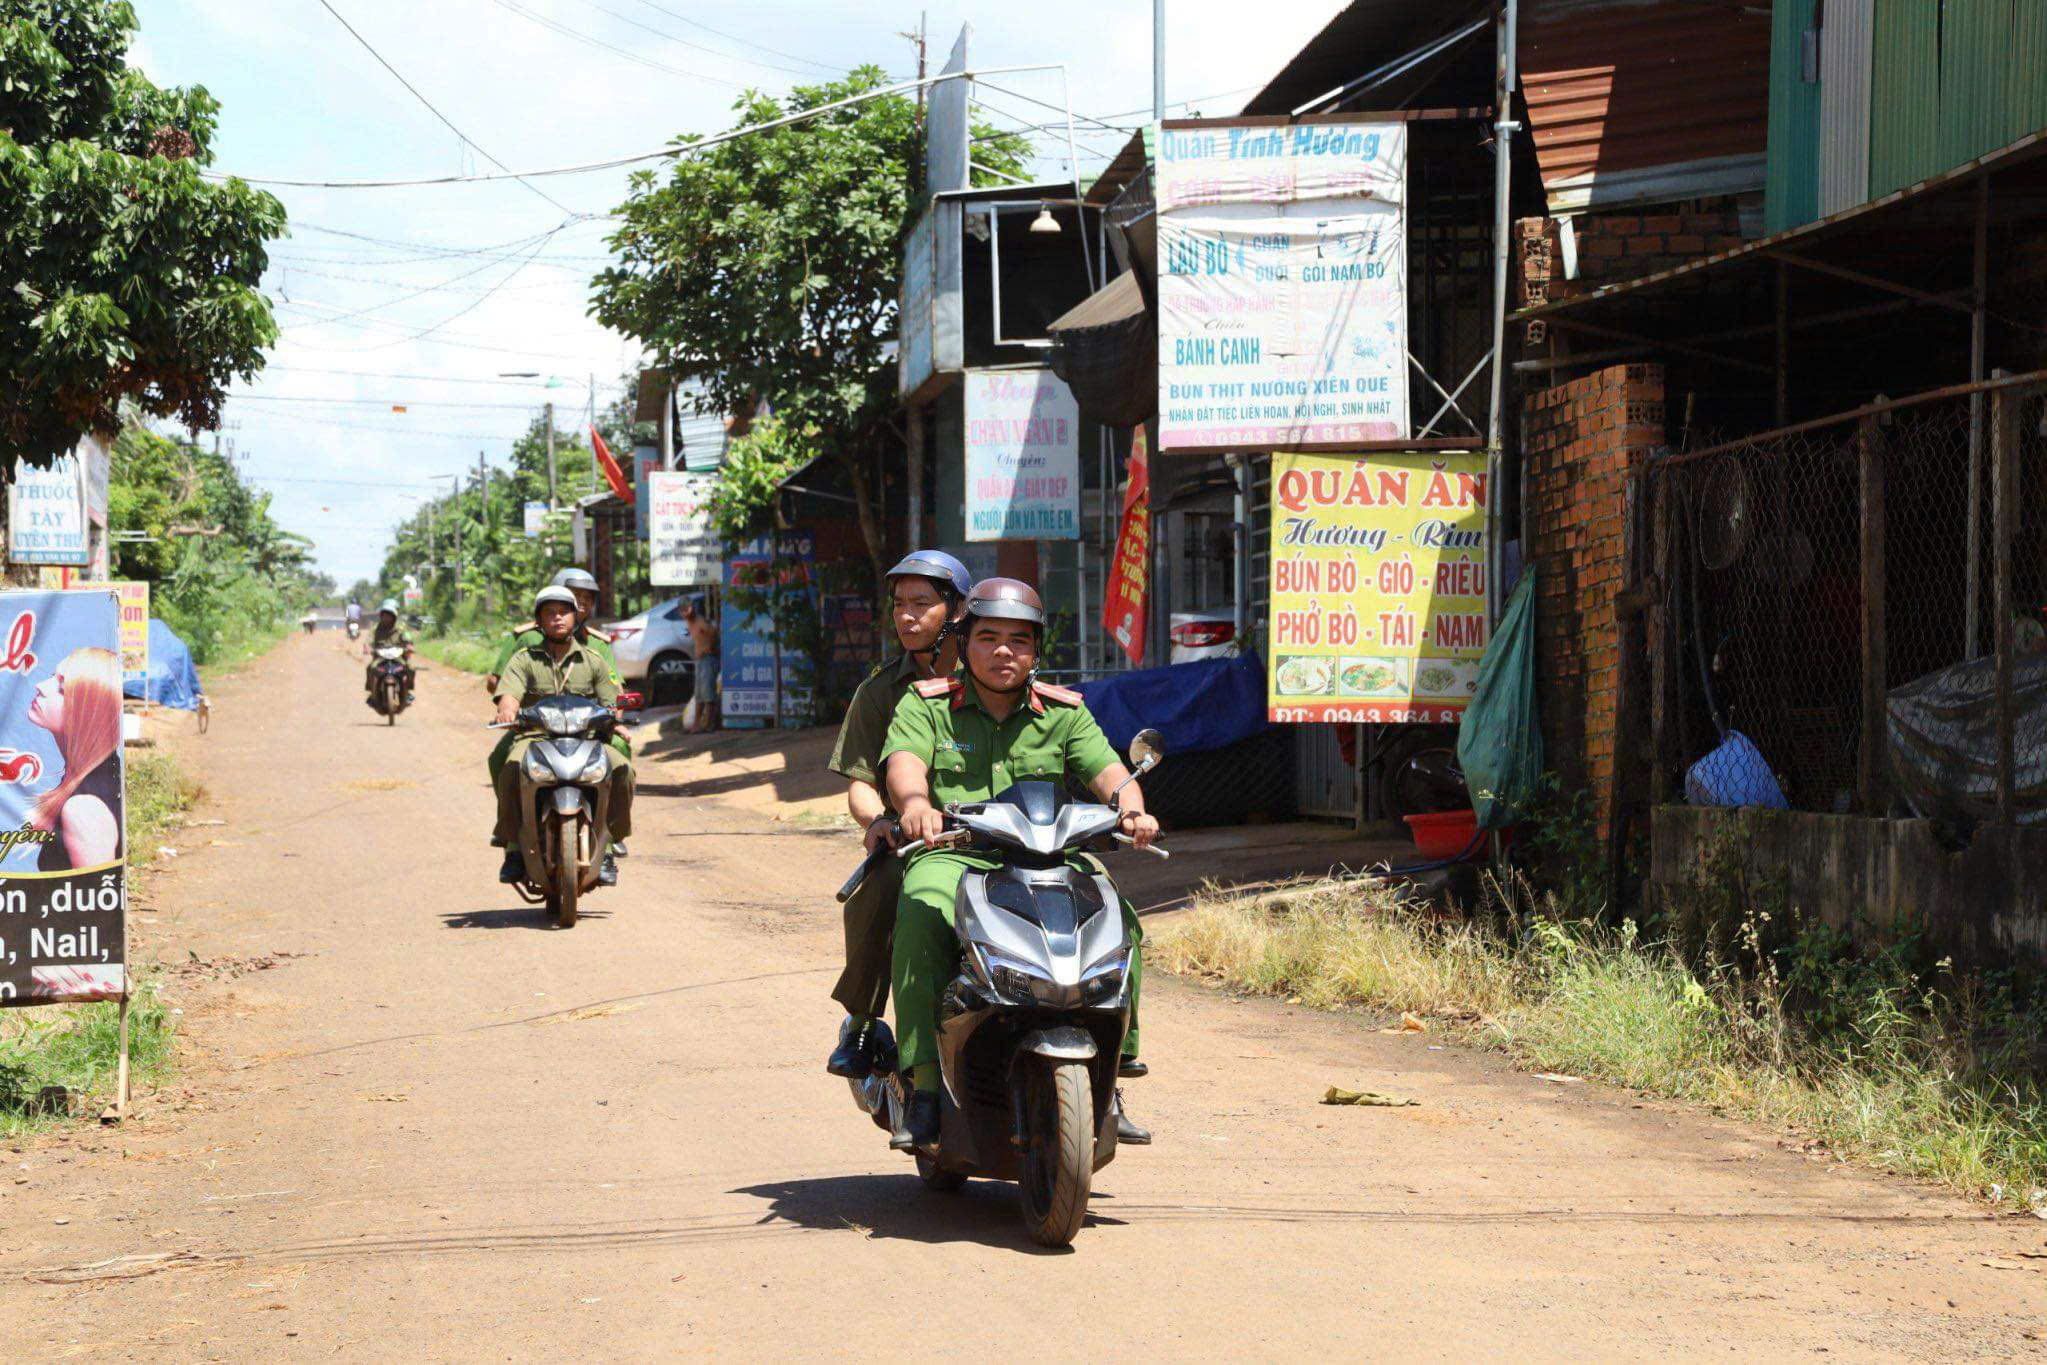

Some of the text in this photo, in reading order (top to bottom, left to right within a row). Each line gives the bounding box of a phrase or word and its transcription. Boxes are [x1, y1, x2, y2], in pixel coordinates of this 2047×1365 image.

[1176, 331, 1260, 366] BÁNH CANH
[1356, 376, 1389, 393] QUE
[1342, 402, 1363, 416] SINH
[1278, 455, 1487, 512] QUÁN ĂN
[31, 508, 65, 527] TÂY
[1282, 517, 1388, 551] Hương
[1276, 552, 1485, 596] BÚN BÒ GIÒ RIÊU
[1277, 600, 1321, 645] PHỞ
[1328, 603, 1357, 645] BÒ
[1380, 604, 1413, 647] TÁI
[31, 926, 109, 962] Nail,
